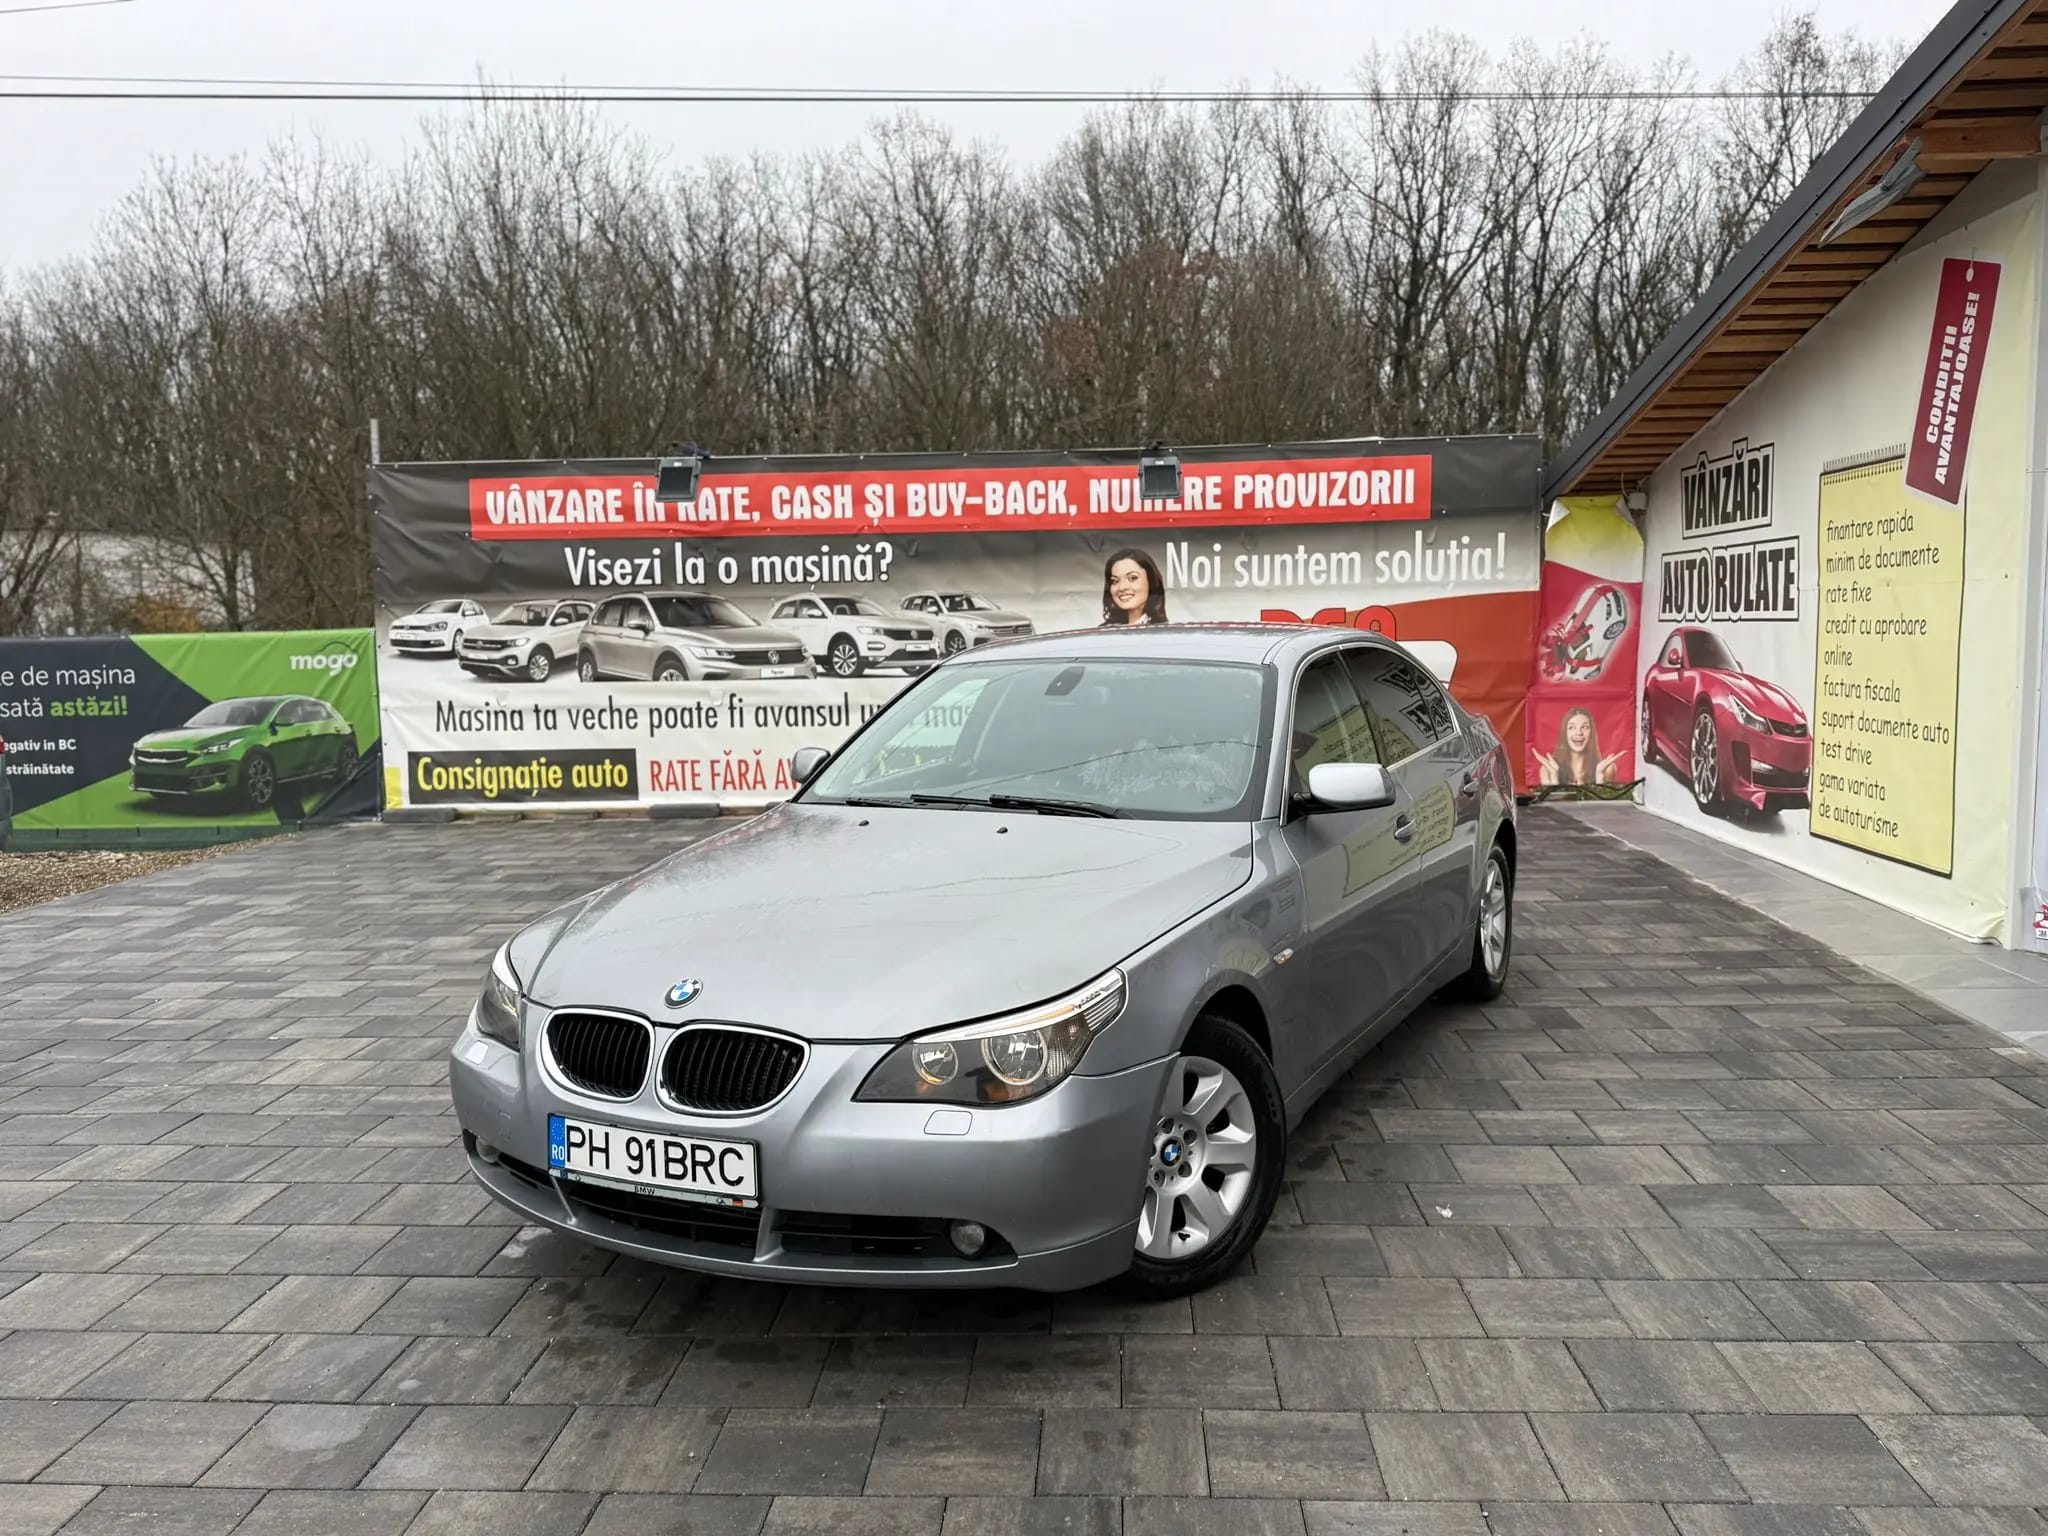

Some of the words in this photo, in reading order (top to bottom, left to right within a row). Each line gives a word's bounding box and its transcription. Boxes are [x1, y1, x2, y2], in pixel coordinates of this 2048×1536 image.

[1934, 291, 1980, 485] AVANTAJOASE!
[485, 483, 624, 525] VÂNZARE
[771, 484, 853, 521] CASH
[864, 483, 895, 526] ȘI
[907, 479, 1078, 518] BUY-BACK,
[1234, 468, 1415, 509] PROVIZORII
[1684, 448, 1770, 531] VÂNZĂRI
[1826, 519, 1873, 543] finantare
[1876, 508, 1914, 541] rapida
[564, 546, 662, 586] Visezi
[674, 541, 705, 585] la
[718, 556, 738, 584] o
[751, 541, 893, 592] mașină?
[1166, 543, 1222, 589] Noi
[1234, 544, 1362, 588] suntem
[1375, 529, 1506, 592] soluția!
[1826, 551, 1855, 573] minim
[1858, 547, 1872, 570] de
[1875, 543, 1940, 569] documente
[1661, 556, 1711, 616] AUTO
[1714, 546, 1796, 614] RULATE
[1825, 584, 1848, 603] rate
[1851, 580, 1872, 604] fixe
[1825, 612, 1856, 635] credit
[1859, 618, 1872, 635] cu
[1874, 612, 1927, 642] aprobare
[289, 654, 359, 677] mogo
[1824, 643, 1853, 666] online
[21, 665, 49, 686] de
[56, 664, 136, 690] mașina
[1823, 674, 1862, 699] factura
[1864, 677, 1901, 703] fiscala
[50, 695, 128, 717] astăzi!
[533, 703, 558, 731] ta
[567, 695, 638, 730] veche
[649, 701, 718, 738] poate
[727, 693, 744, 729] fi
[754, 691, 850, 728] avansul
[43, 739, 56, 751] in
[58, 738, 77, 751] BC
[1821, 709, 1855, 734] suport
[1857, 709, 1920, 740] documente
[1922, 721, 1950, 745] auto
[6, 763, 75, 775] străinătate
[1821, 738, 1842, 759] test
[1844, 740, 1873, 765] drive
[417, 757, 563, 799] Consignație
[571, 758, 629, 789] auto
[649, 759, 703, 792] RATE
[710, 750, 767, 792] FĂRĂ
[1819, 772, 1845, 793] gama
[1847, 776, 1886, 801] variata
[1819, 797, 1831, 819] de
[1833, 805, 1899, 838] autoturisme
[551, 1143, 565, 1161] RO
[566, 1124, 610, 1170] PH
